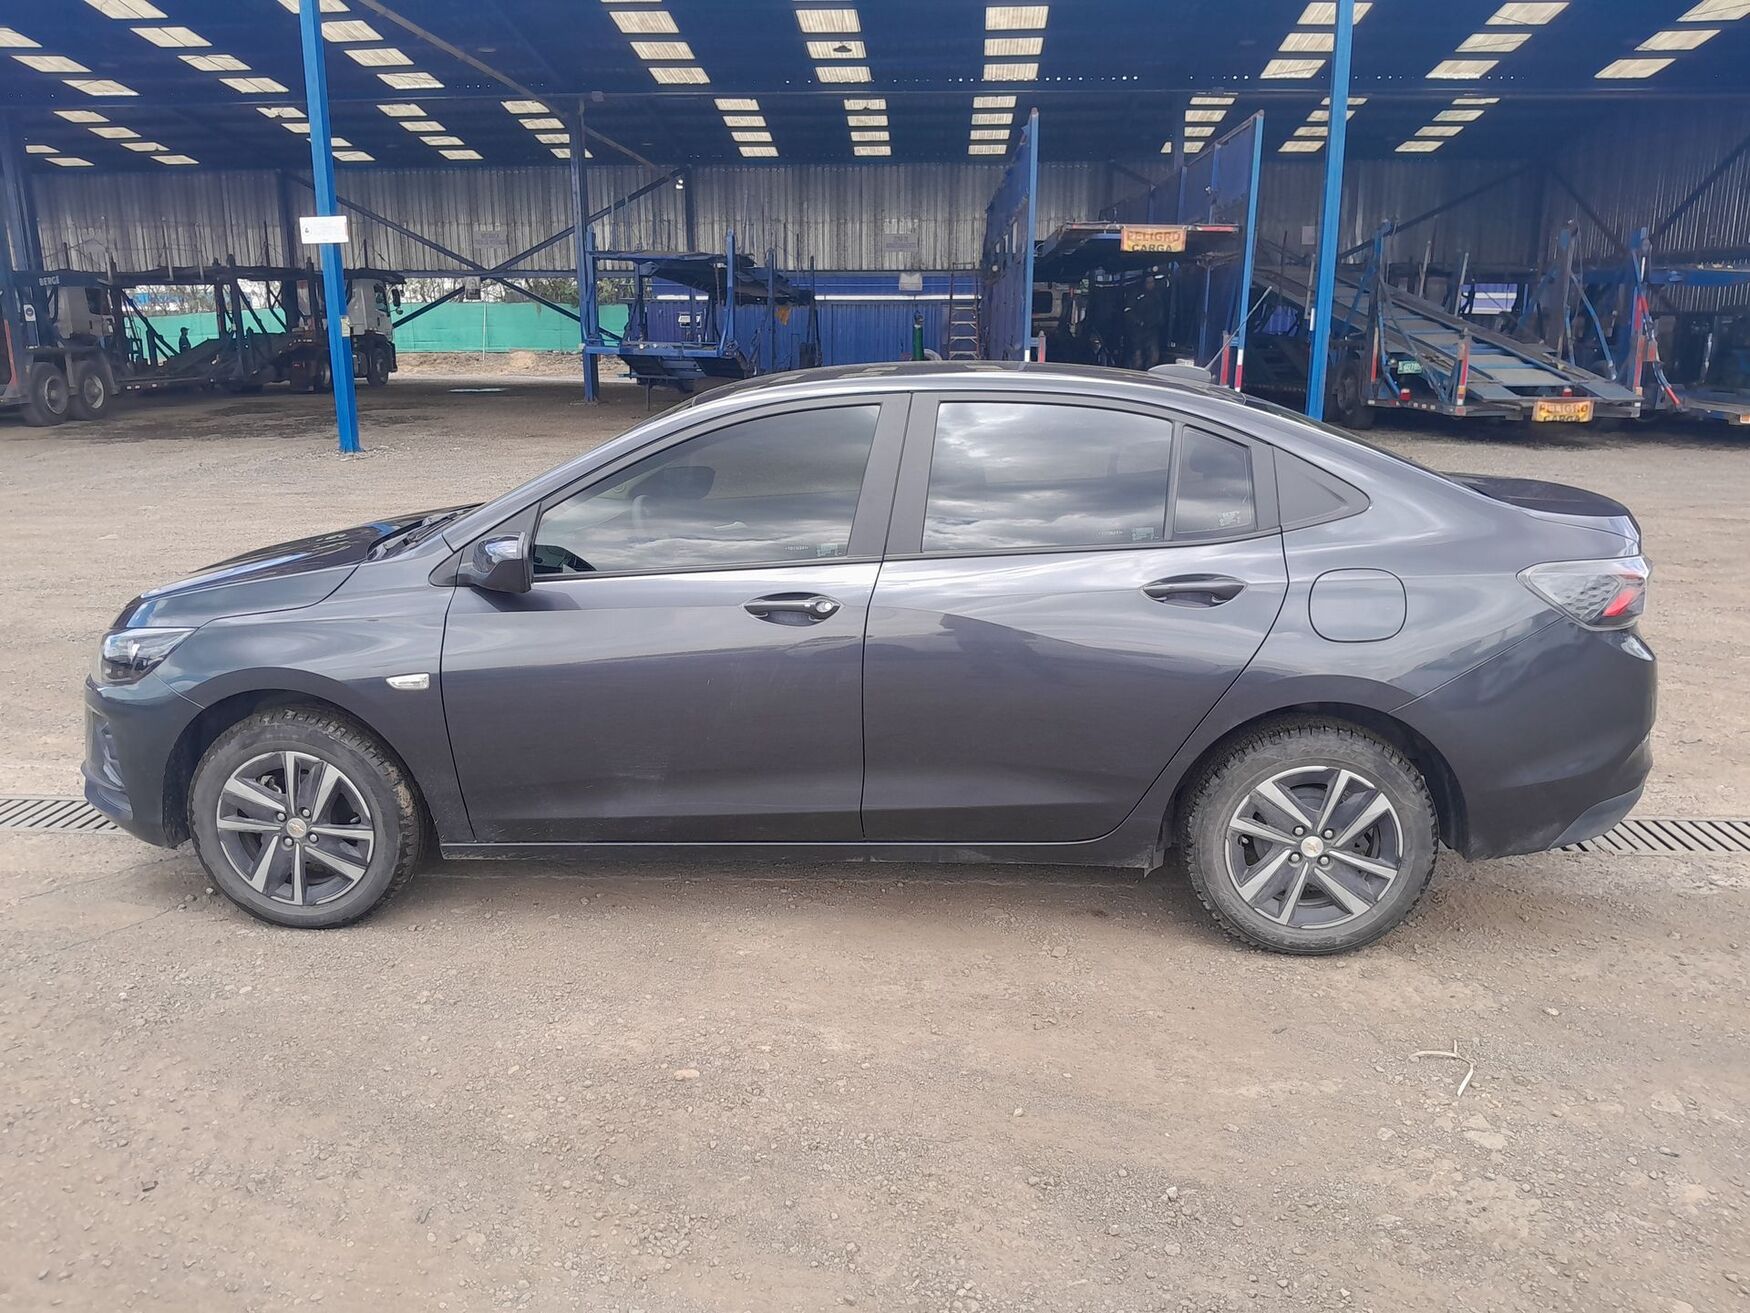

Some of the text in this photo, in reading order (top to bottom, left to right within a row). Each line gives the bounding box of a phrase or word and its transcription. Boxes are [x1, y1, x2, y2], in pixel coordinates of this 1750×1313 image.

[1127, 231, 1181, 243] PELIGRO
[1131, 244, 1173, 252] CARGA
[1539, 403, 1589, 413] PELIGRO
[1543, 414, 1581, 422] CARGA
